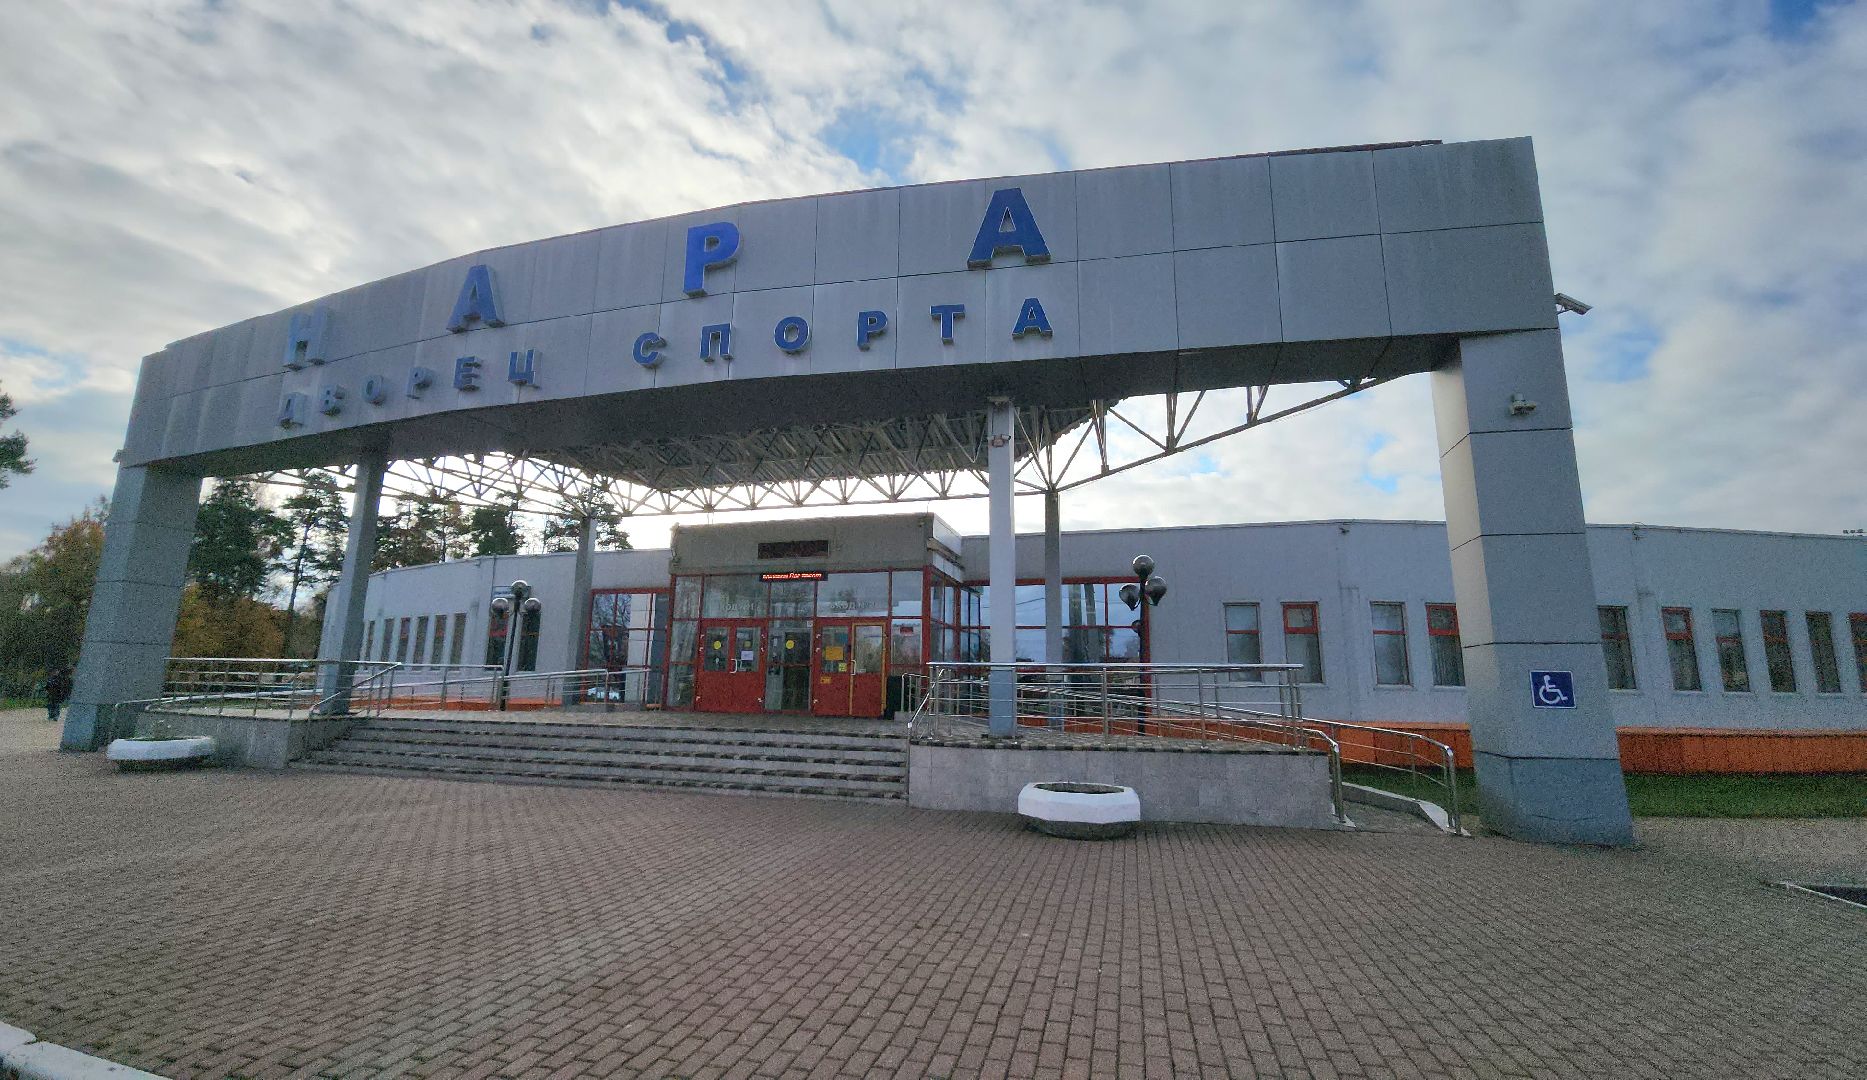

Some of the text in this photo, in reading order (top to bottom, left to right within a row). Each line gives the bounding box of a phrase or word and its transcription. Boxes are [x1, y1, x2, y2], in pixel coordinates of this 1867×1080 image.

[284, 186, 1051, 370] НАРА
[278, 297, 1053, 428] ДВОРЕЦ СПОРТА
